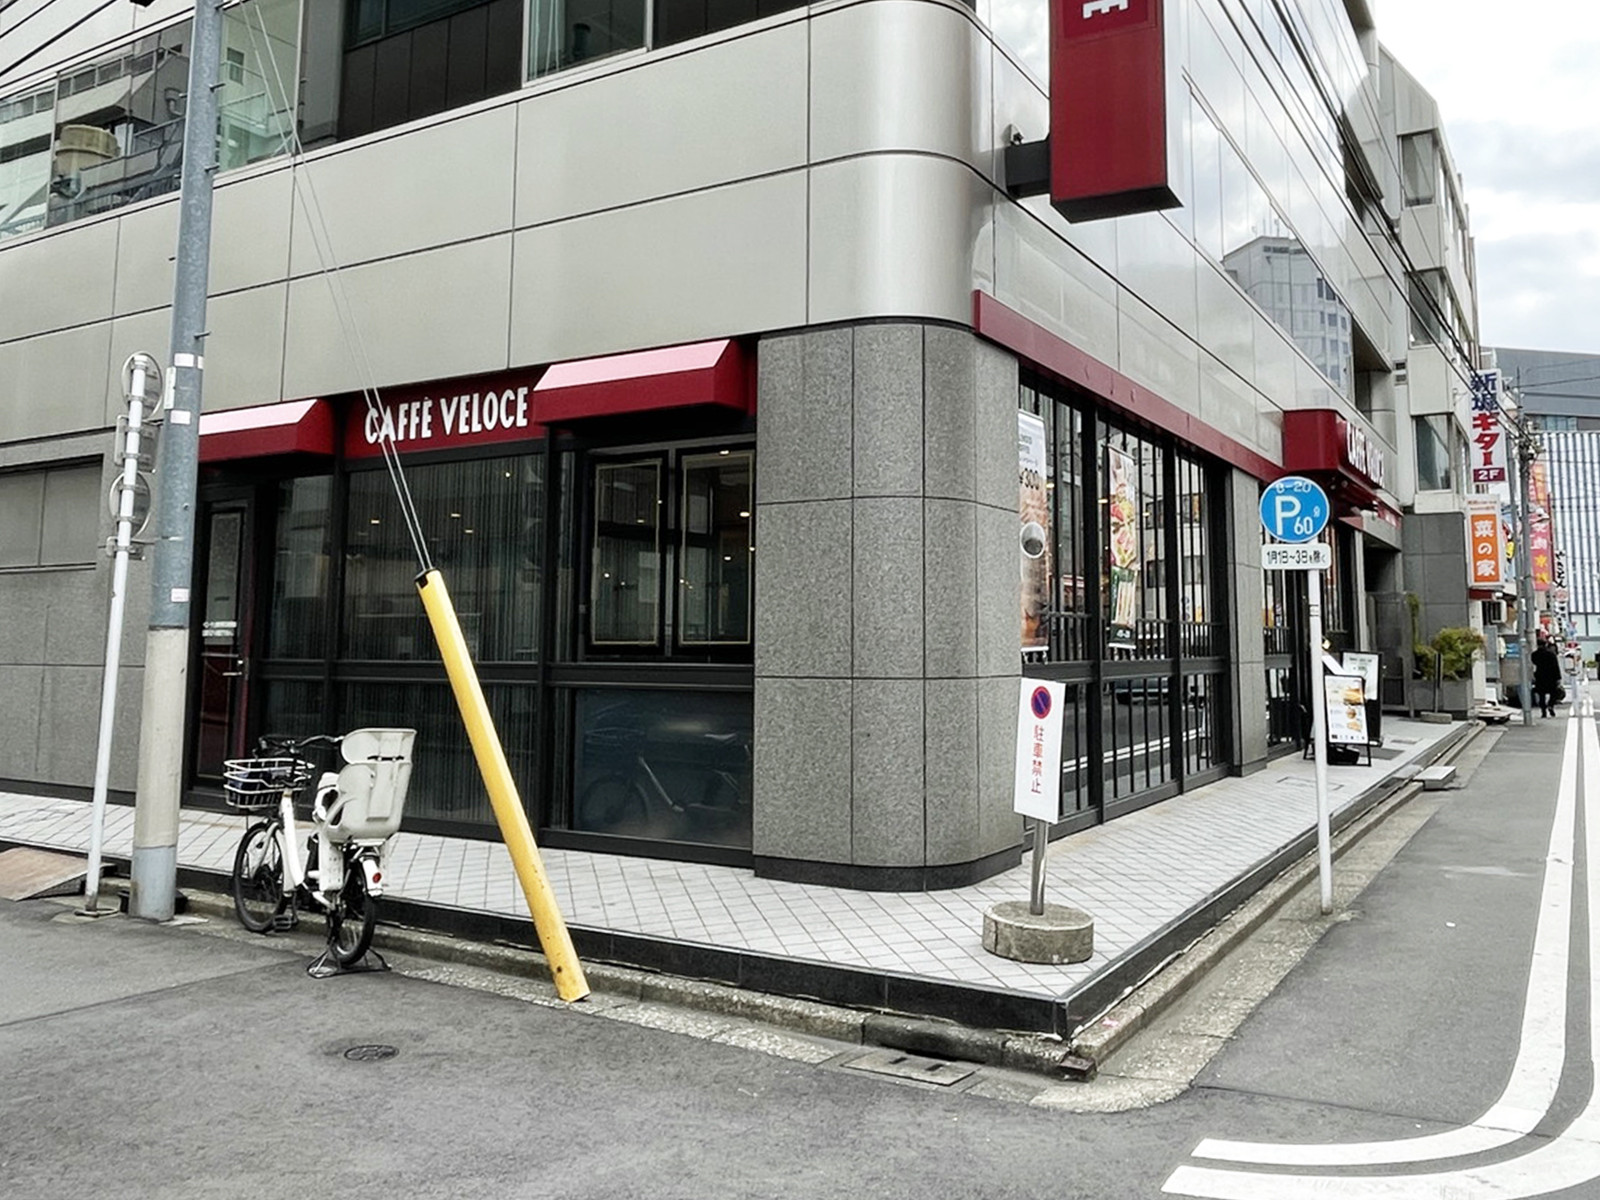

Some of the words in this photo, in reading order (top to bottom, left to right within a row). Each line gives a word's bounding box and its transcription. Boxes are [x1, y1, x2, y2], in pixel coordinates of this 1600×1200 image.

[365, 397, 433, 444] CAFFÈ
[440, 387, 528, 436] VELOCE
[1478, 470, 1499, 480] 2F
[1275, 495, 1302, 536] P
[1294, 516, 1313, 535] 60
[1474, 520, 1496, 577] 菜の家
[1031, 724, 1045, 794] 駐車禁止
